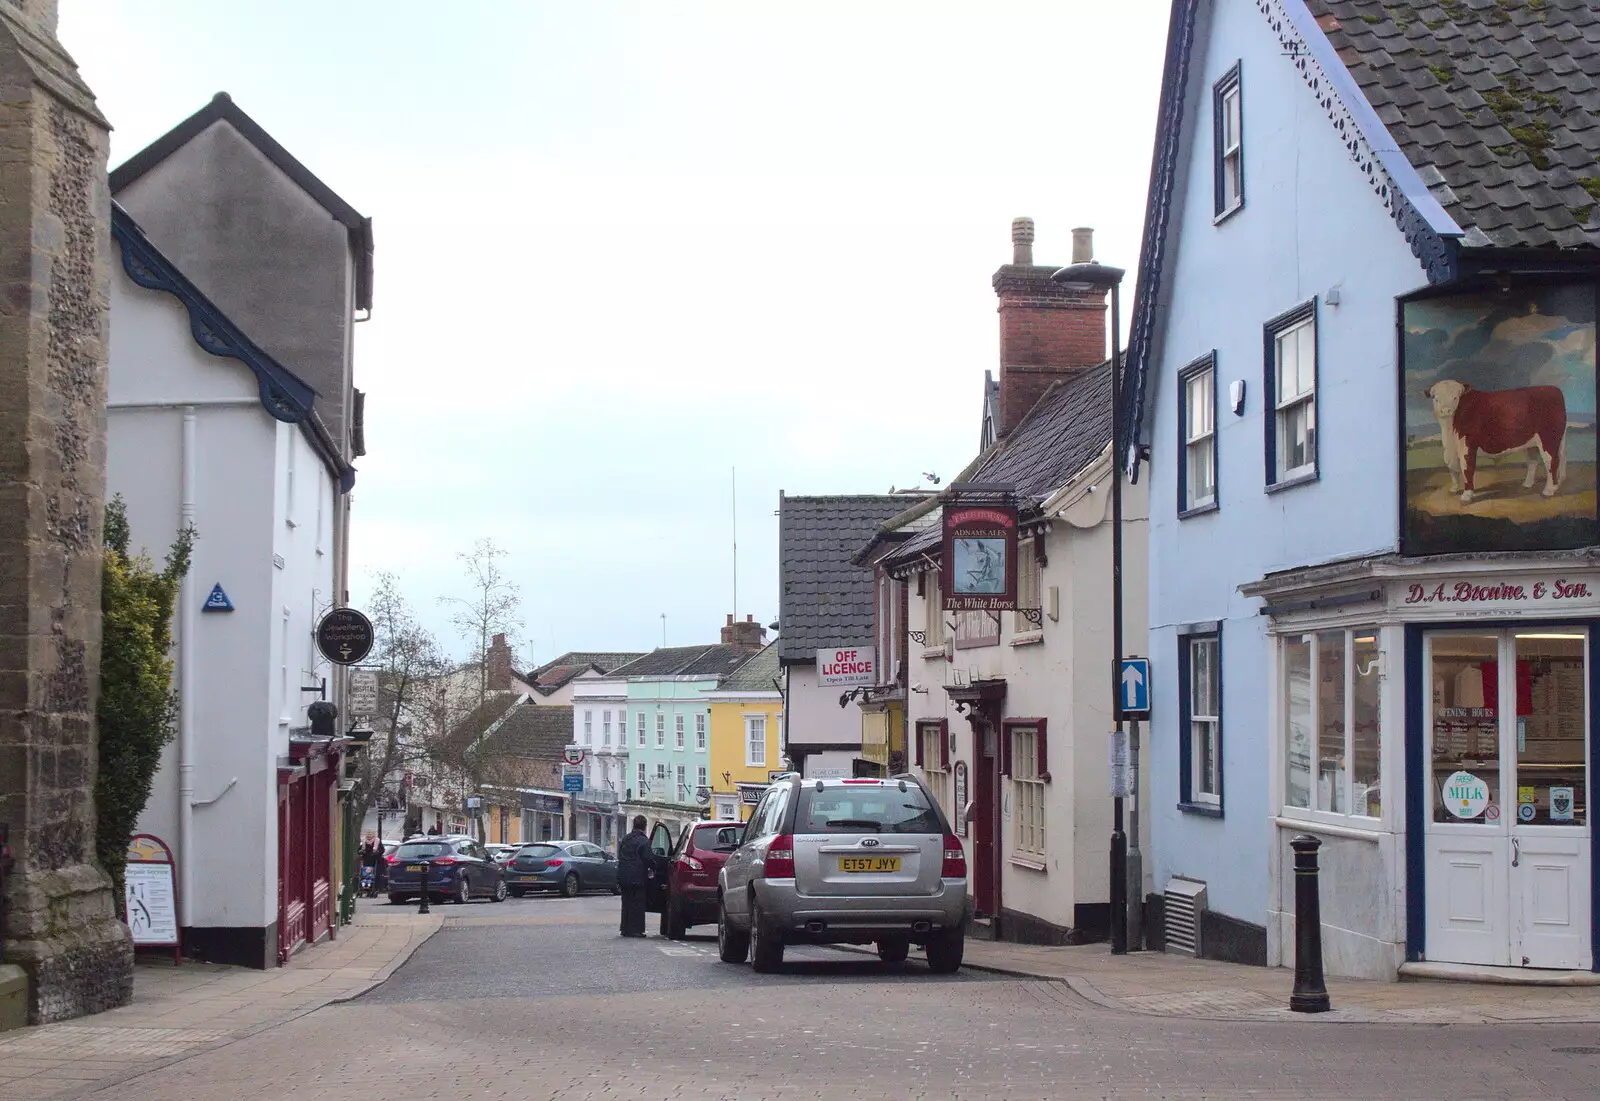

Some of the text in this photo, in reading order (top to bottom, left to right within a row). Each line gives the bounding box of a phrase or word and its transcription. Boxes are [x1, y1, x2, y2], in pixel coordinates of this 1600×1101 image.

[1533, 582, 1547, 600] &
[1552, 579, 1592, 600] Son.
[946, 598, 1014, 609] The White Horse
[325, 623, 365, 632] Jewellery
[835, 650, 857, 663] OFF
[822, 661, 872, 675] LICENCE
[1439, 707, 1494, 717] OPENING HOURS
[743, 791, 756, 799] DISS
[1448, 787, 1484, 800] MILK
[843, 859, 897, 870] ET57 JYY
